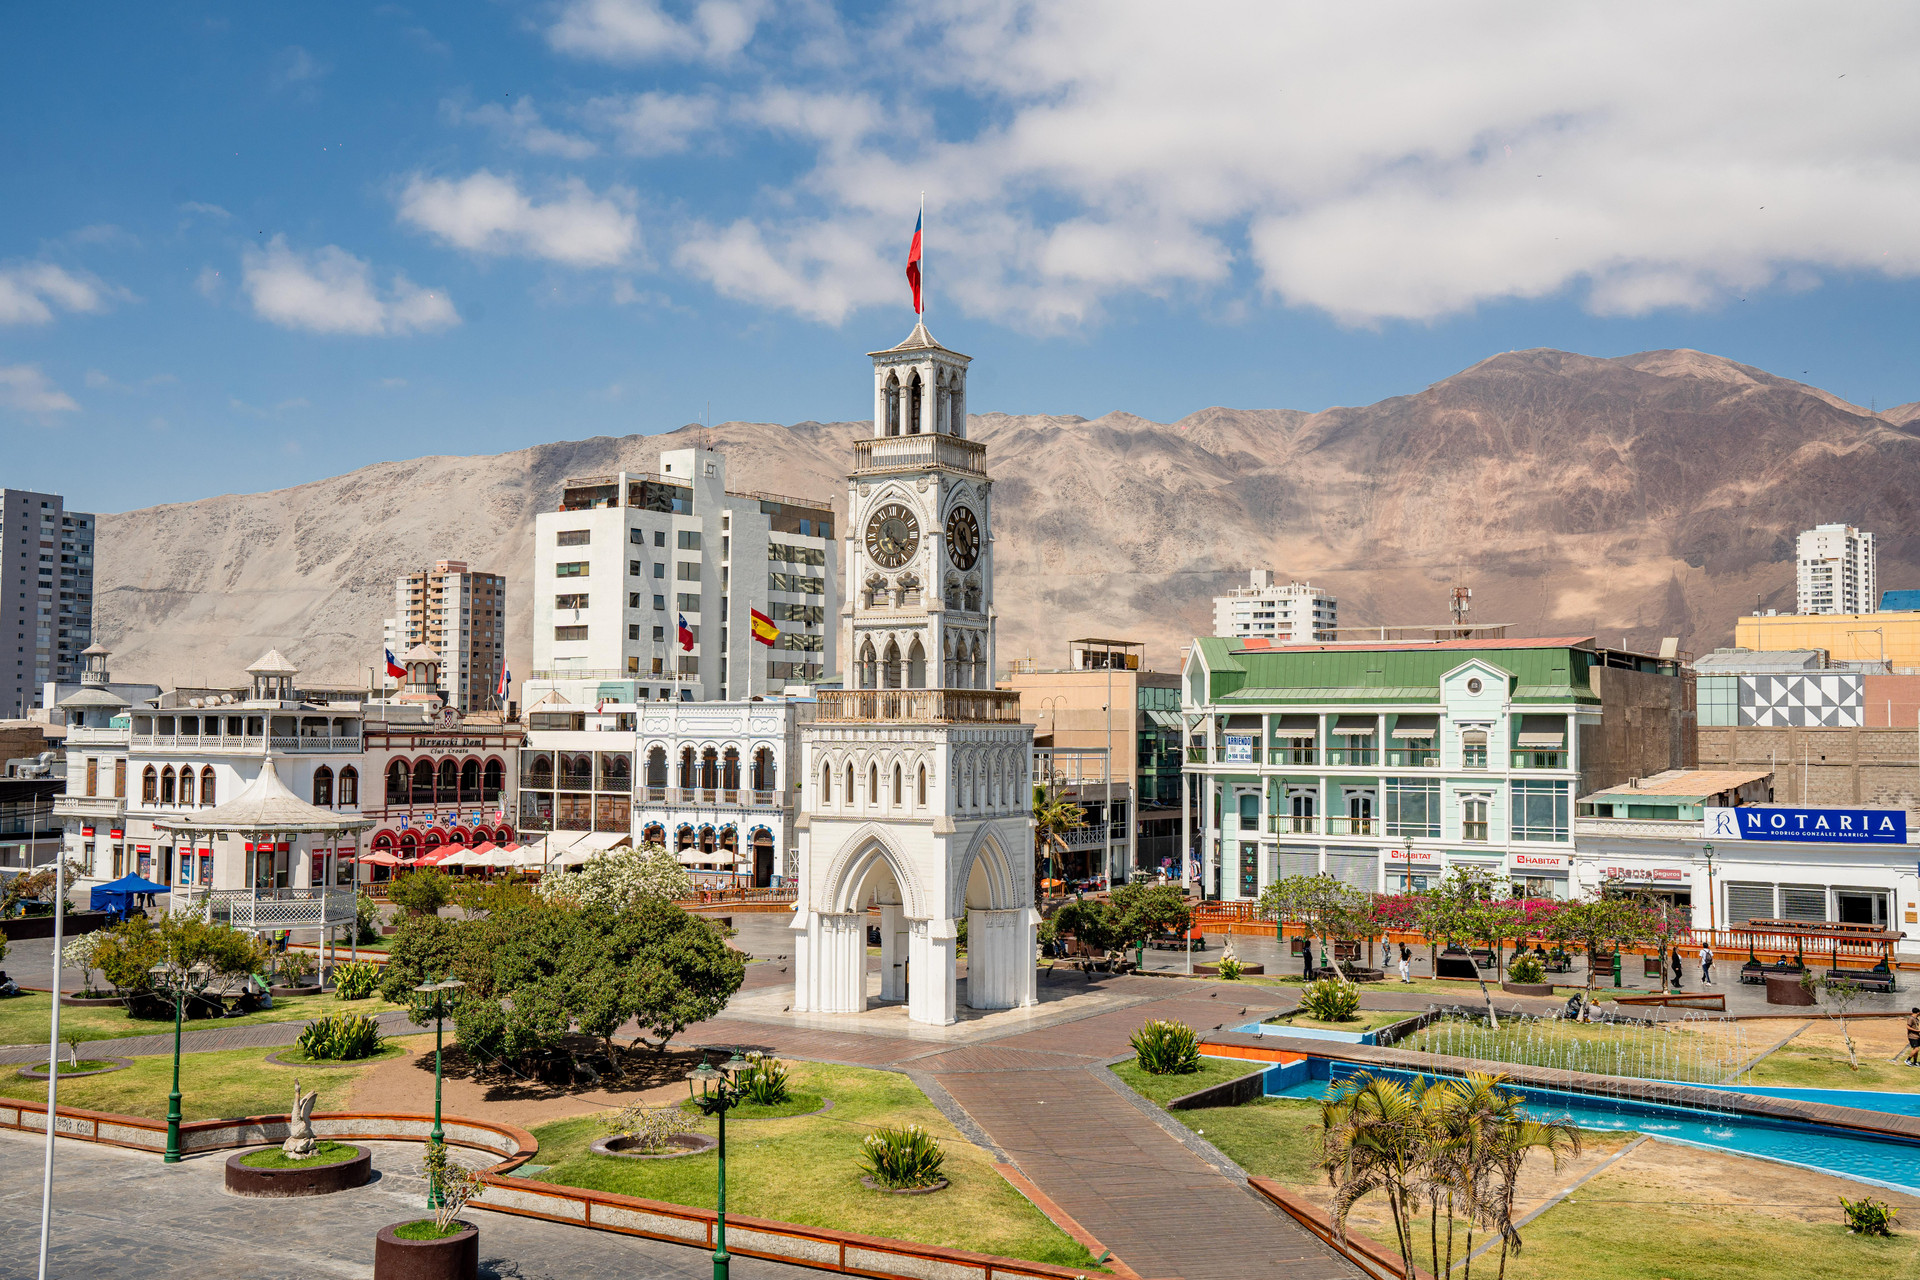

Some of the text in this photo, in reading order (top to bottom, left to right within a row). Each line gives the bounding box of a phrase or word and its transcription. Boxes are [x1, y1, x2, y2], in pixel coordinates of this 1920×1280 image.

[877, 510, 887, 521] XI
[889, 506, 897, 516] XII
[901, 509, 906, 519] I
[870, 520, 880, 530] X
[907, 518, 916, 527] II
[867, 533, 876, 541] IX
[909, 531, 918, 539] III
[419, 737, 482, 746] Hrvatski Dom
[1747, 813, 1895, 831] NOTARIA
[1526, 857, 1560, 865] HABITAT
